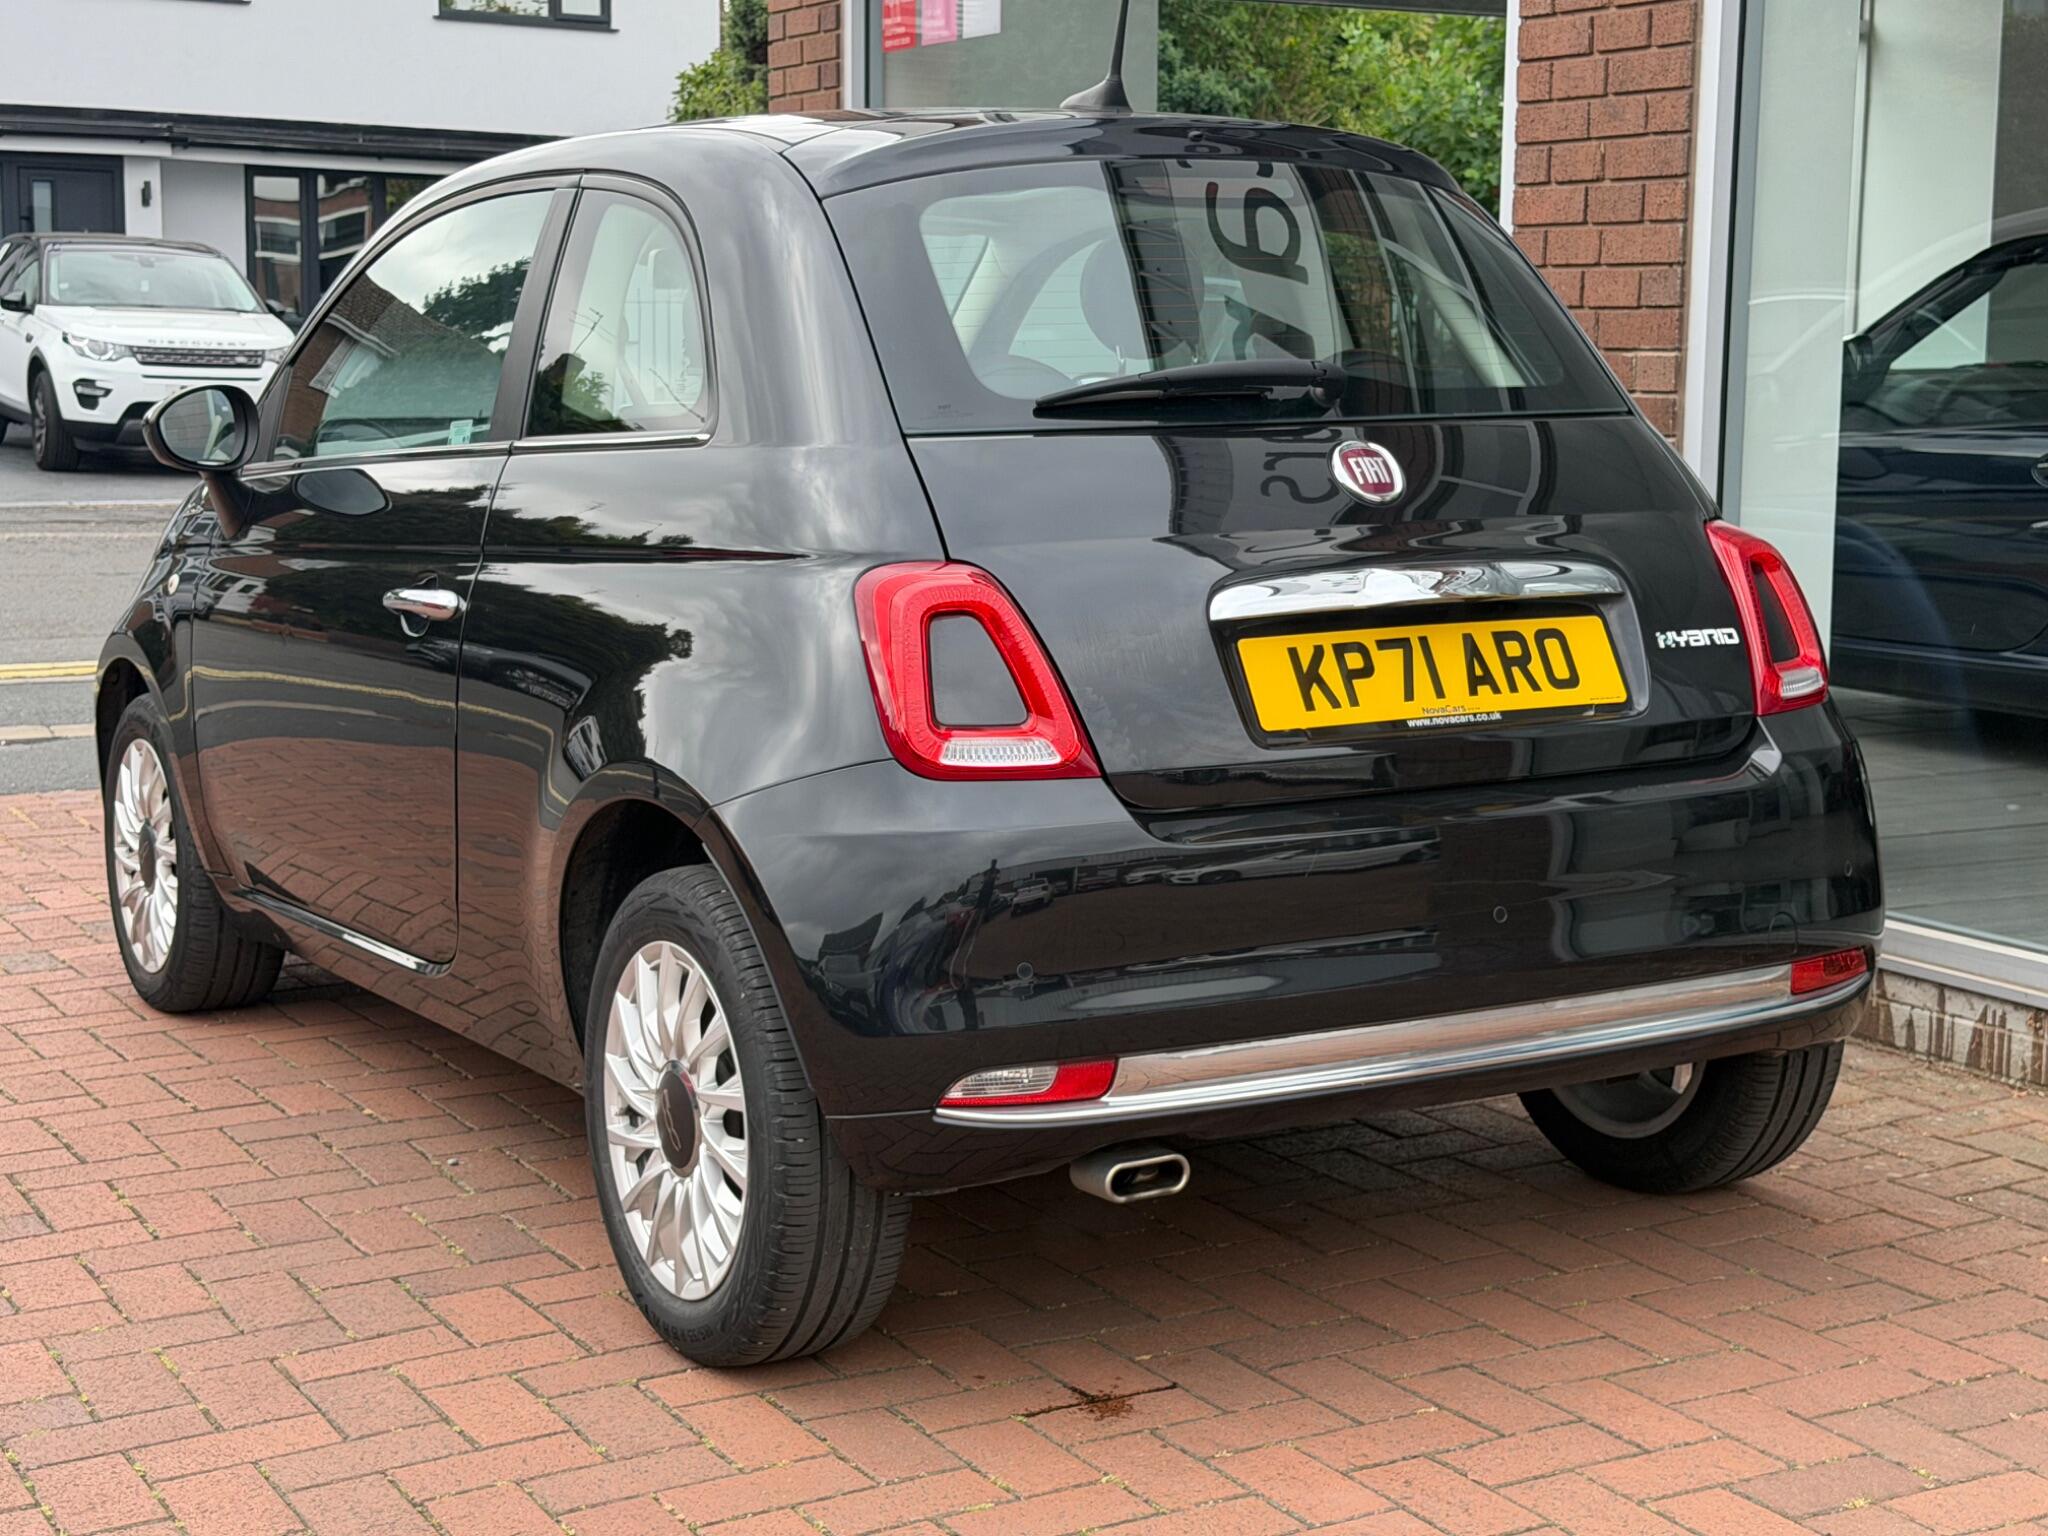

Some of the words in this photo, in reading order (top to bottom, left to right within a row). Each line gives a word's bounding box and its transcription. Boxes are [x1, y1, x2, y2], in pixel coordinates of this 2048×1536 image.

[1347, 456, 1391, 484] FIAT
[1655, 627, 1740, 649] HYBRID
[1287, 635, 1446, 712] KP71
[1462, 627, 1580, 697] ARO
[1407, 712, 1502, 727] www.novacars.co.uk
[1422, 705, 1466, 715] NovaCars
